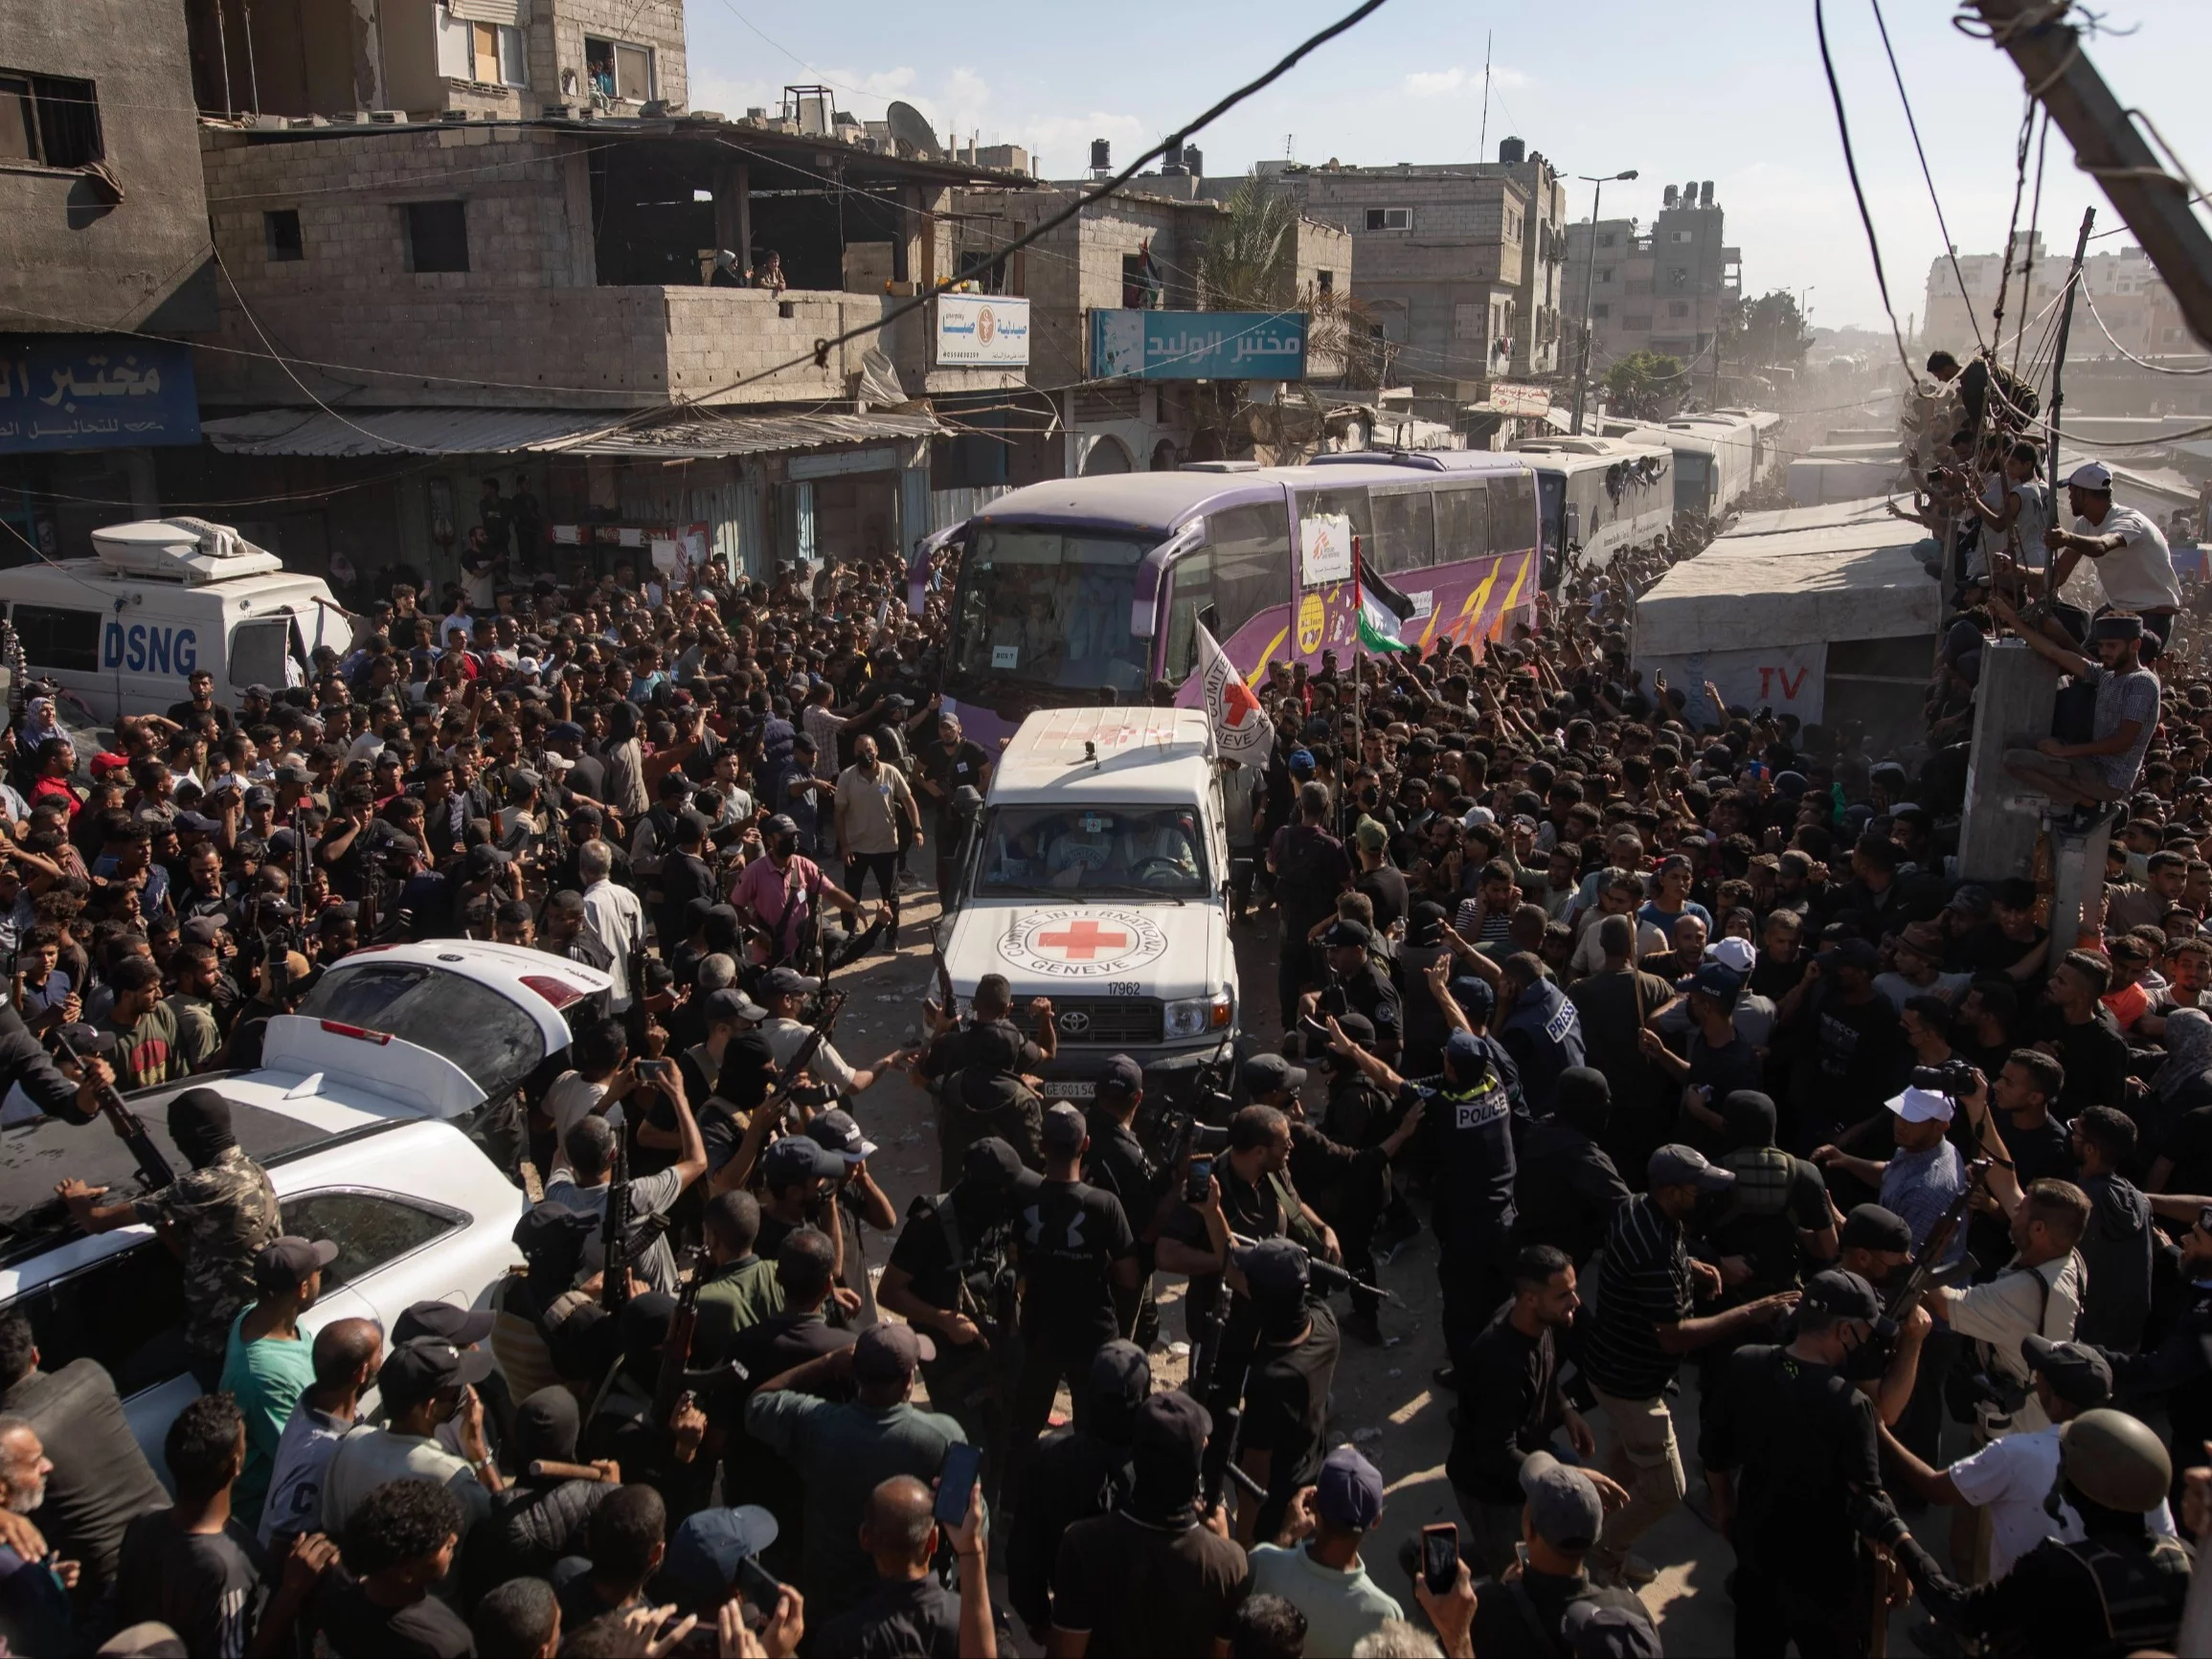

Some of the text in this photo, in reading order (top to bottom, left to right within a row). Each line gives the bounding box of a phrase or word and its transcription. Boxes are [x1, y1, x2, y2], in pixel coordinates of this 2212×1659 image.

[943, 315, 1027, 340] صيدلية صبا
[1146, 329, 1300, 365] مختبر الوليد
[38, 354, 161, 414] مختبر
[28, 418, 119, 440] للتحاليل
[104, 622, 197, 676] DSNG
[1206, 655, 1229, 718] COMITE
[1758, 666, 1808, 702] TV
[1004, 908, 1162, 957] COMITE INTERNATIONAL
[1030, 959, 1130, 975] GENEVE
[1107, 982, 1140, 996] 17962
[1702, 984, 1723, 998] POLICE
[1547, 998, 1576, 1039] PRESS
[1458, 1094, 1508, 1127] POLICE
[289, 1481, 319, 1513] C
